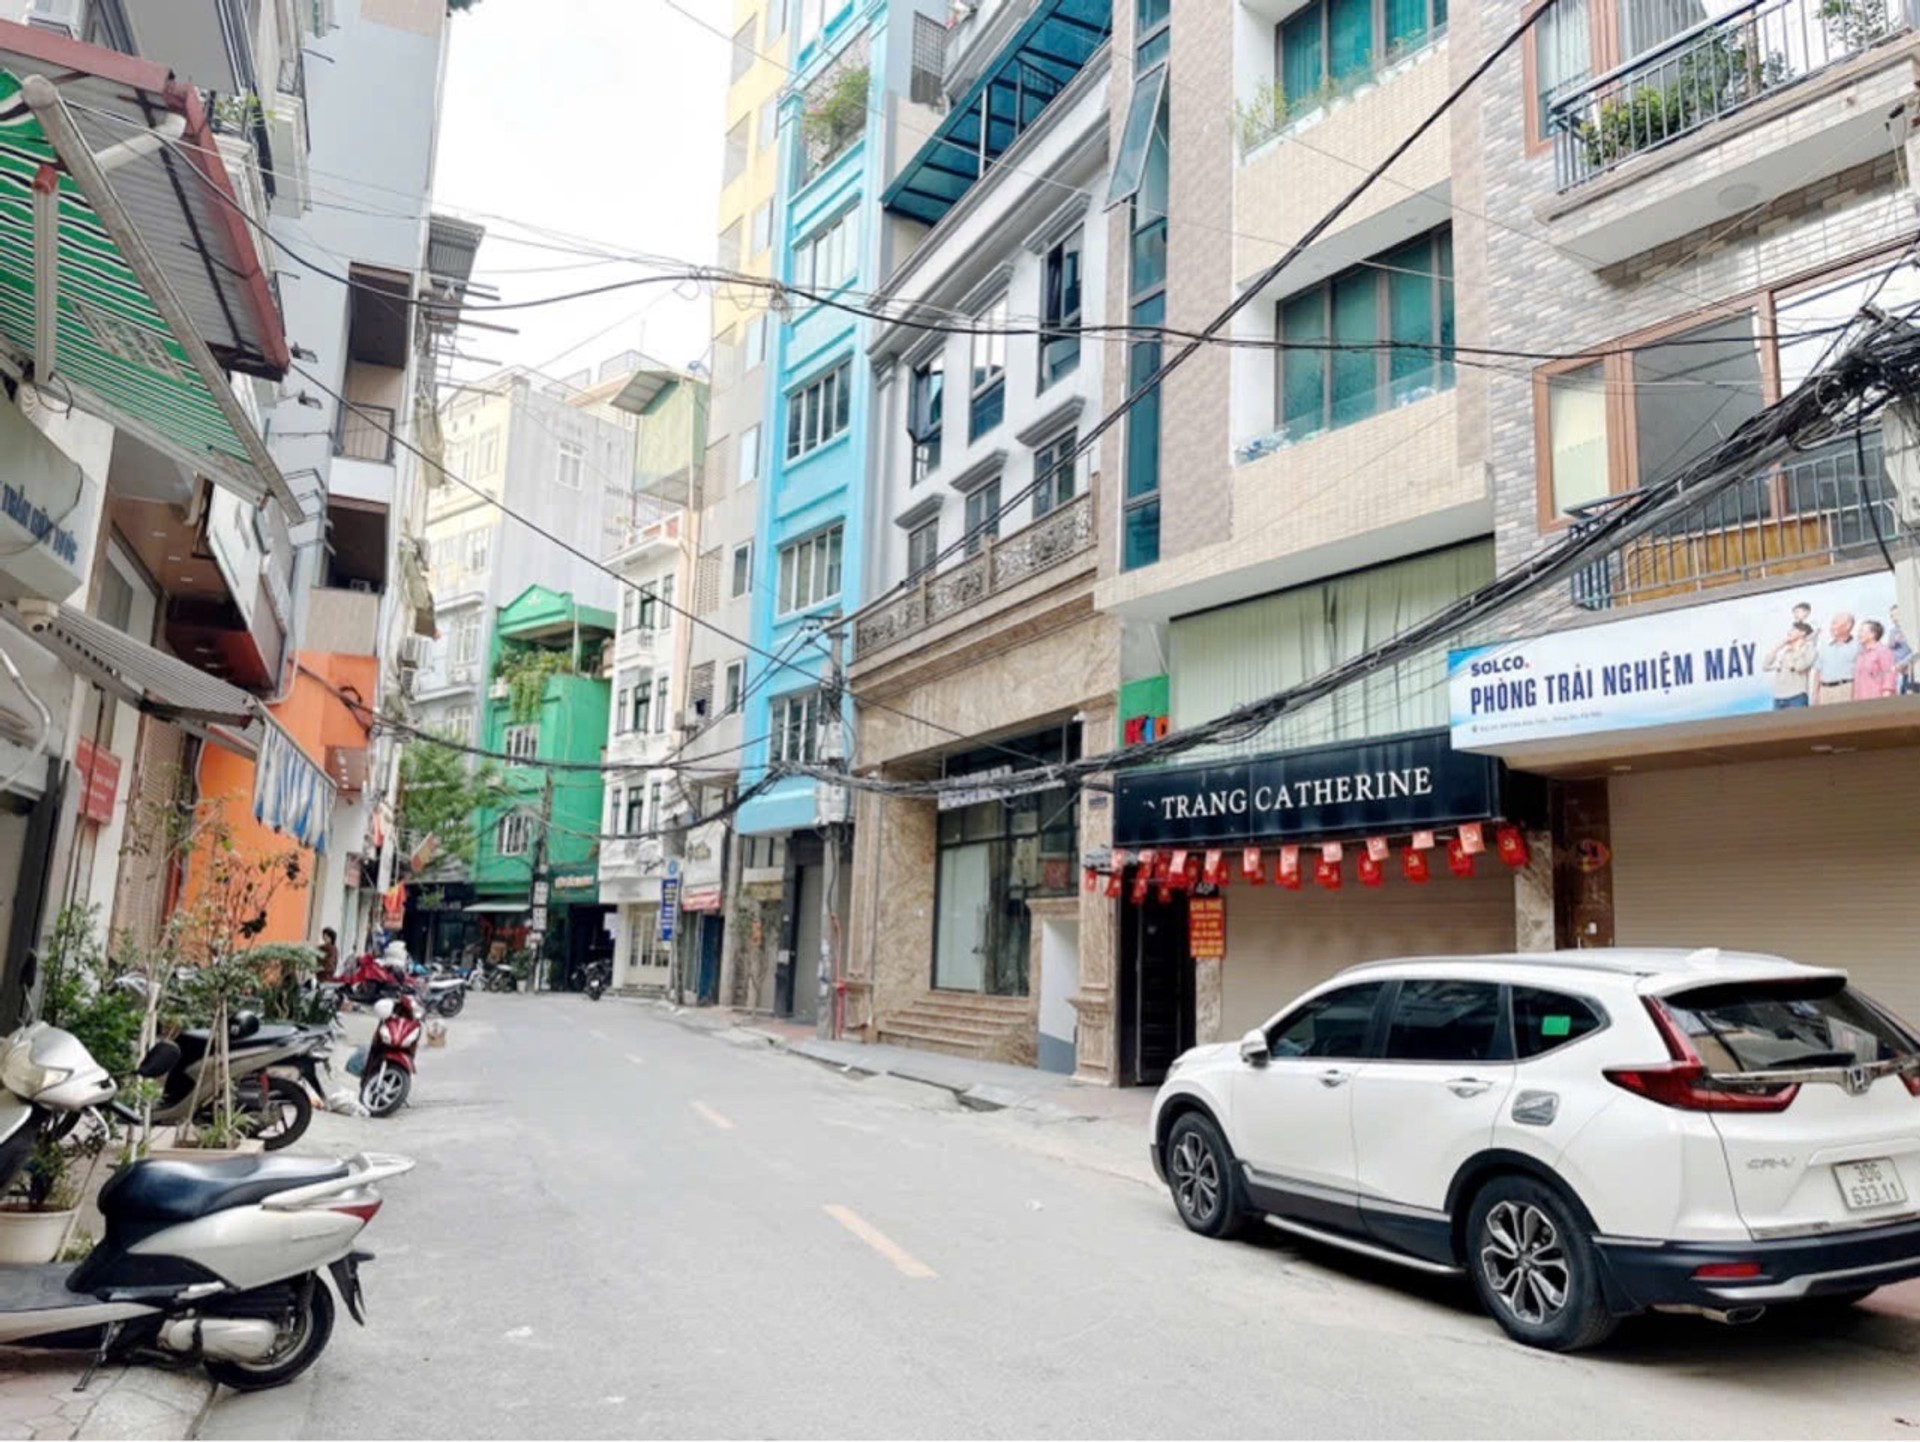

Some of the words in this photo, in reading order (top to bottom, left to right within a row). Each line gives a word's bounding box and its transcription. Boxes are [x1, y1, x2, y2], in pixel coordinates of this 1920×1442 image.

[1470, 676, 1537, 715] PHÒNG
[1545, 664, 1593, 704] TRẢI
[1603, 651, 1693, 696] NGHIỆM
[1704, 639, 1757, 682] MÁY
[1161, 789, 1247, 820] TRANG
[1254, 767, 1434, 812] CATHERINE
